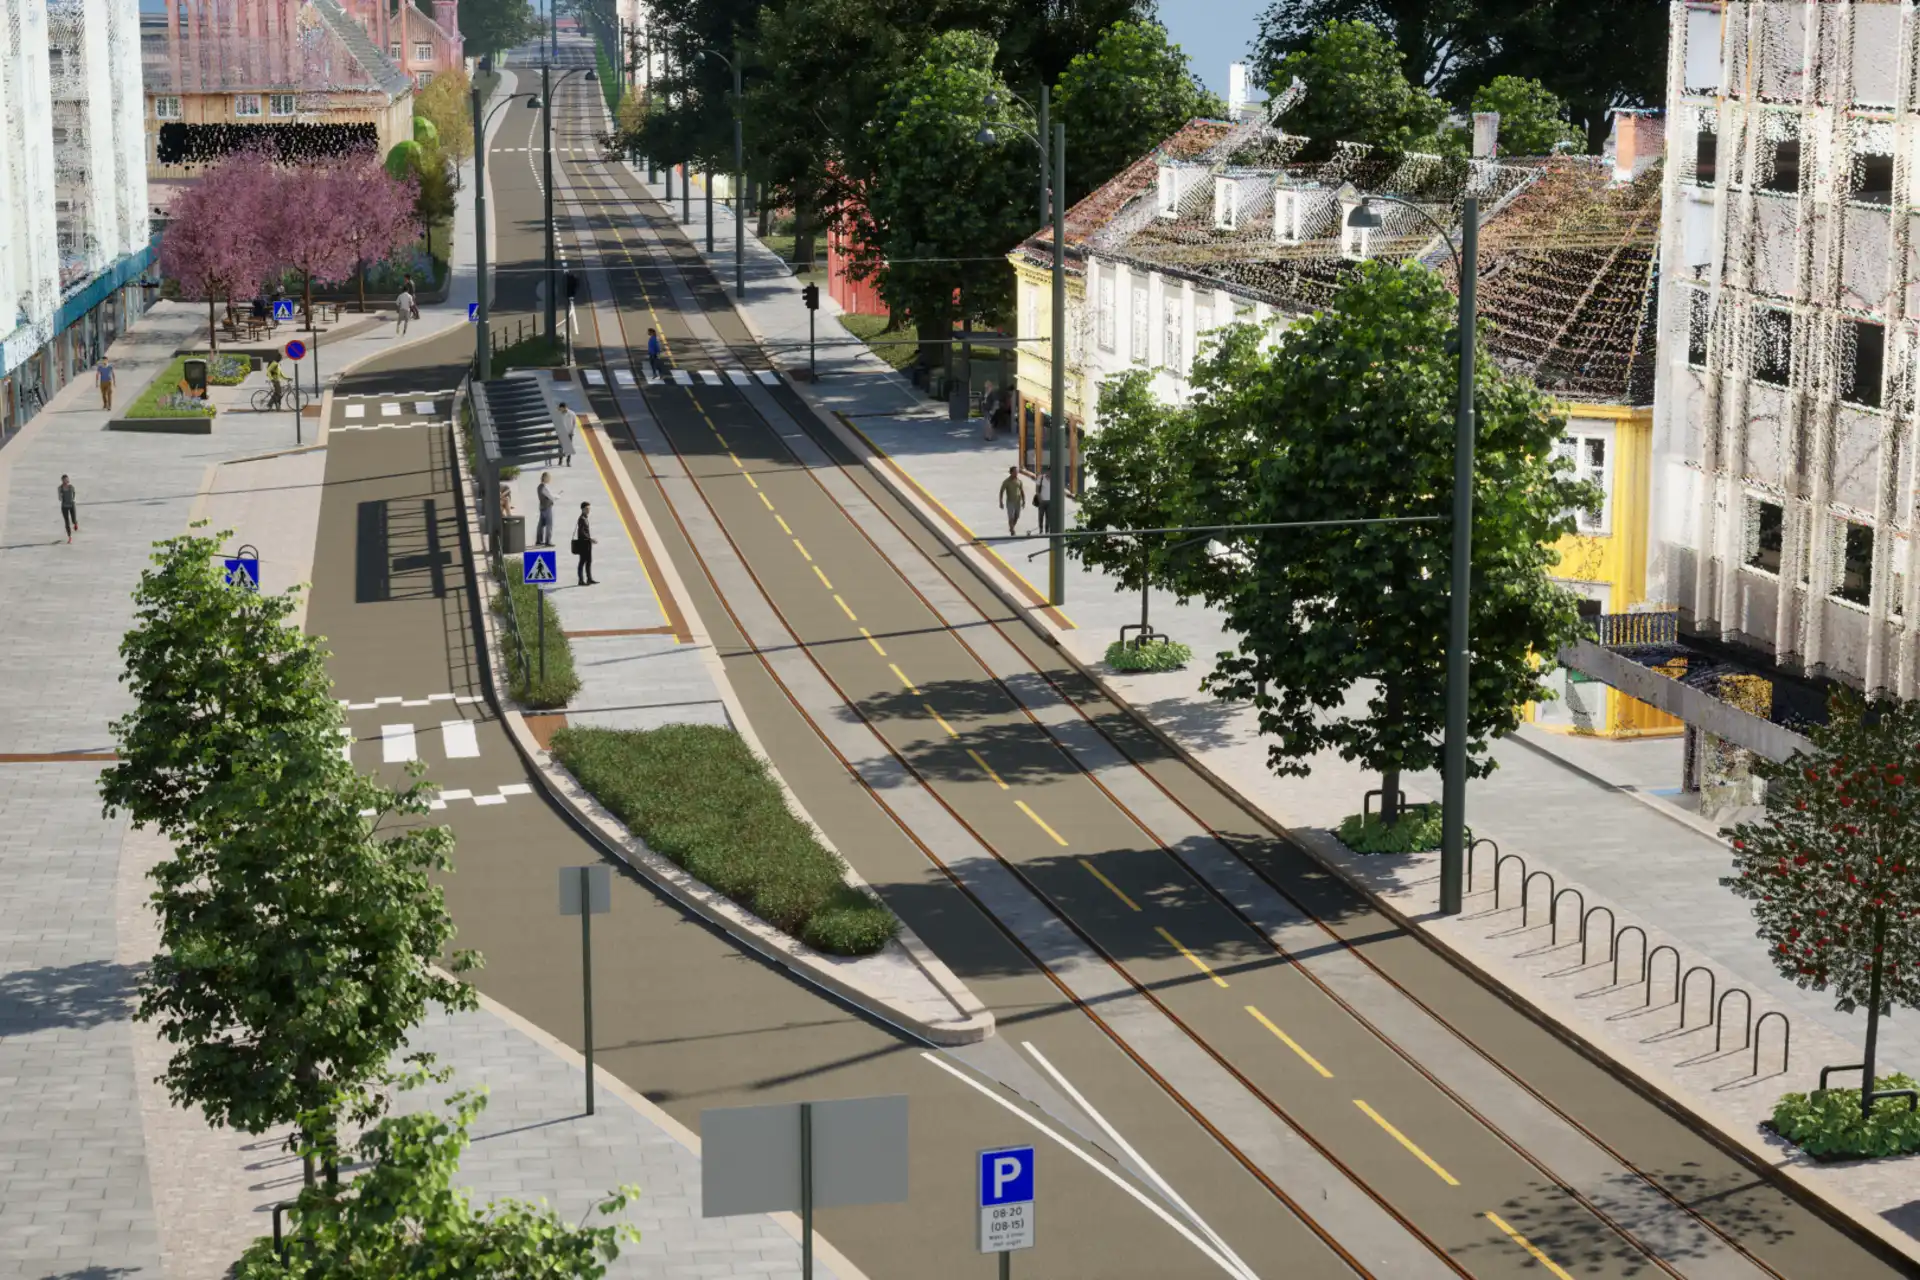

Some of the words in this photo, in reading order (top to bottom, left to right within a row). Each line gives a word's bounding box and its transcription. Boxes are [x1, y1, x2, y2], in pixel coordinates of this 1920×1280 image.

[993, 1156, 1022, 1199] P
[993, 1206, 1022, 1218] 08-20
[991, 1218, 1025, 1232] (08-15)
